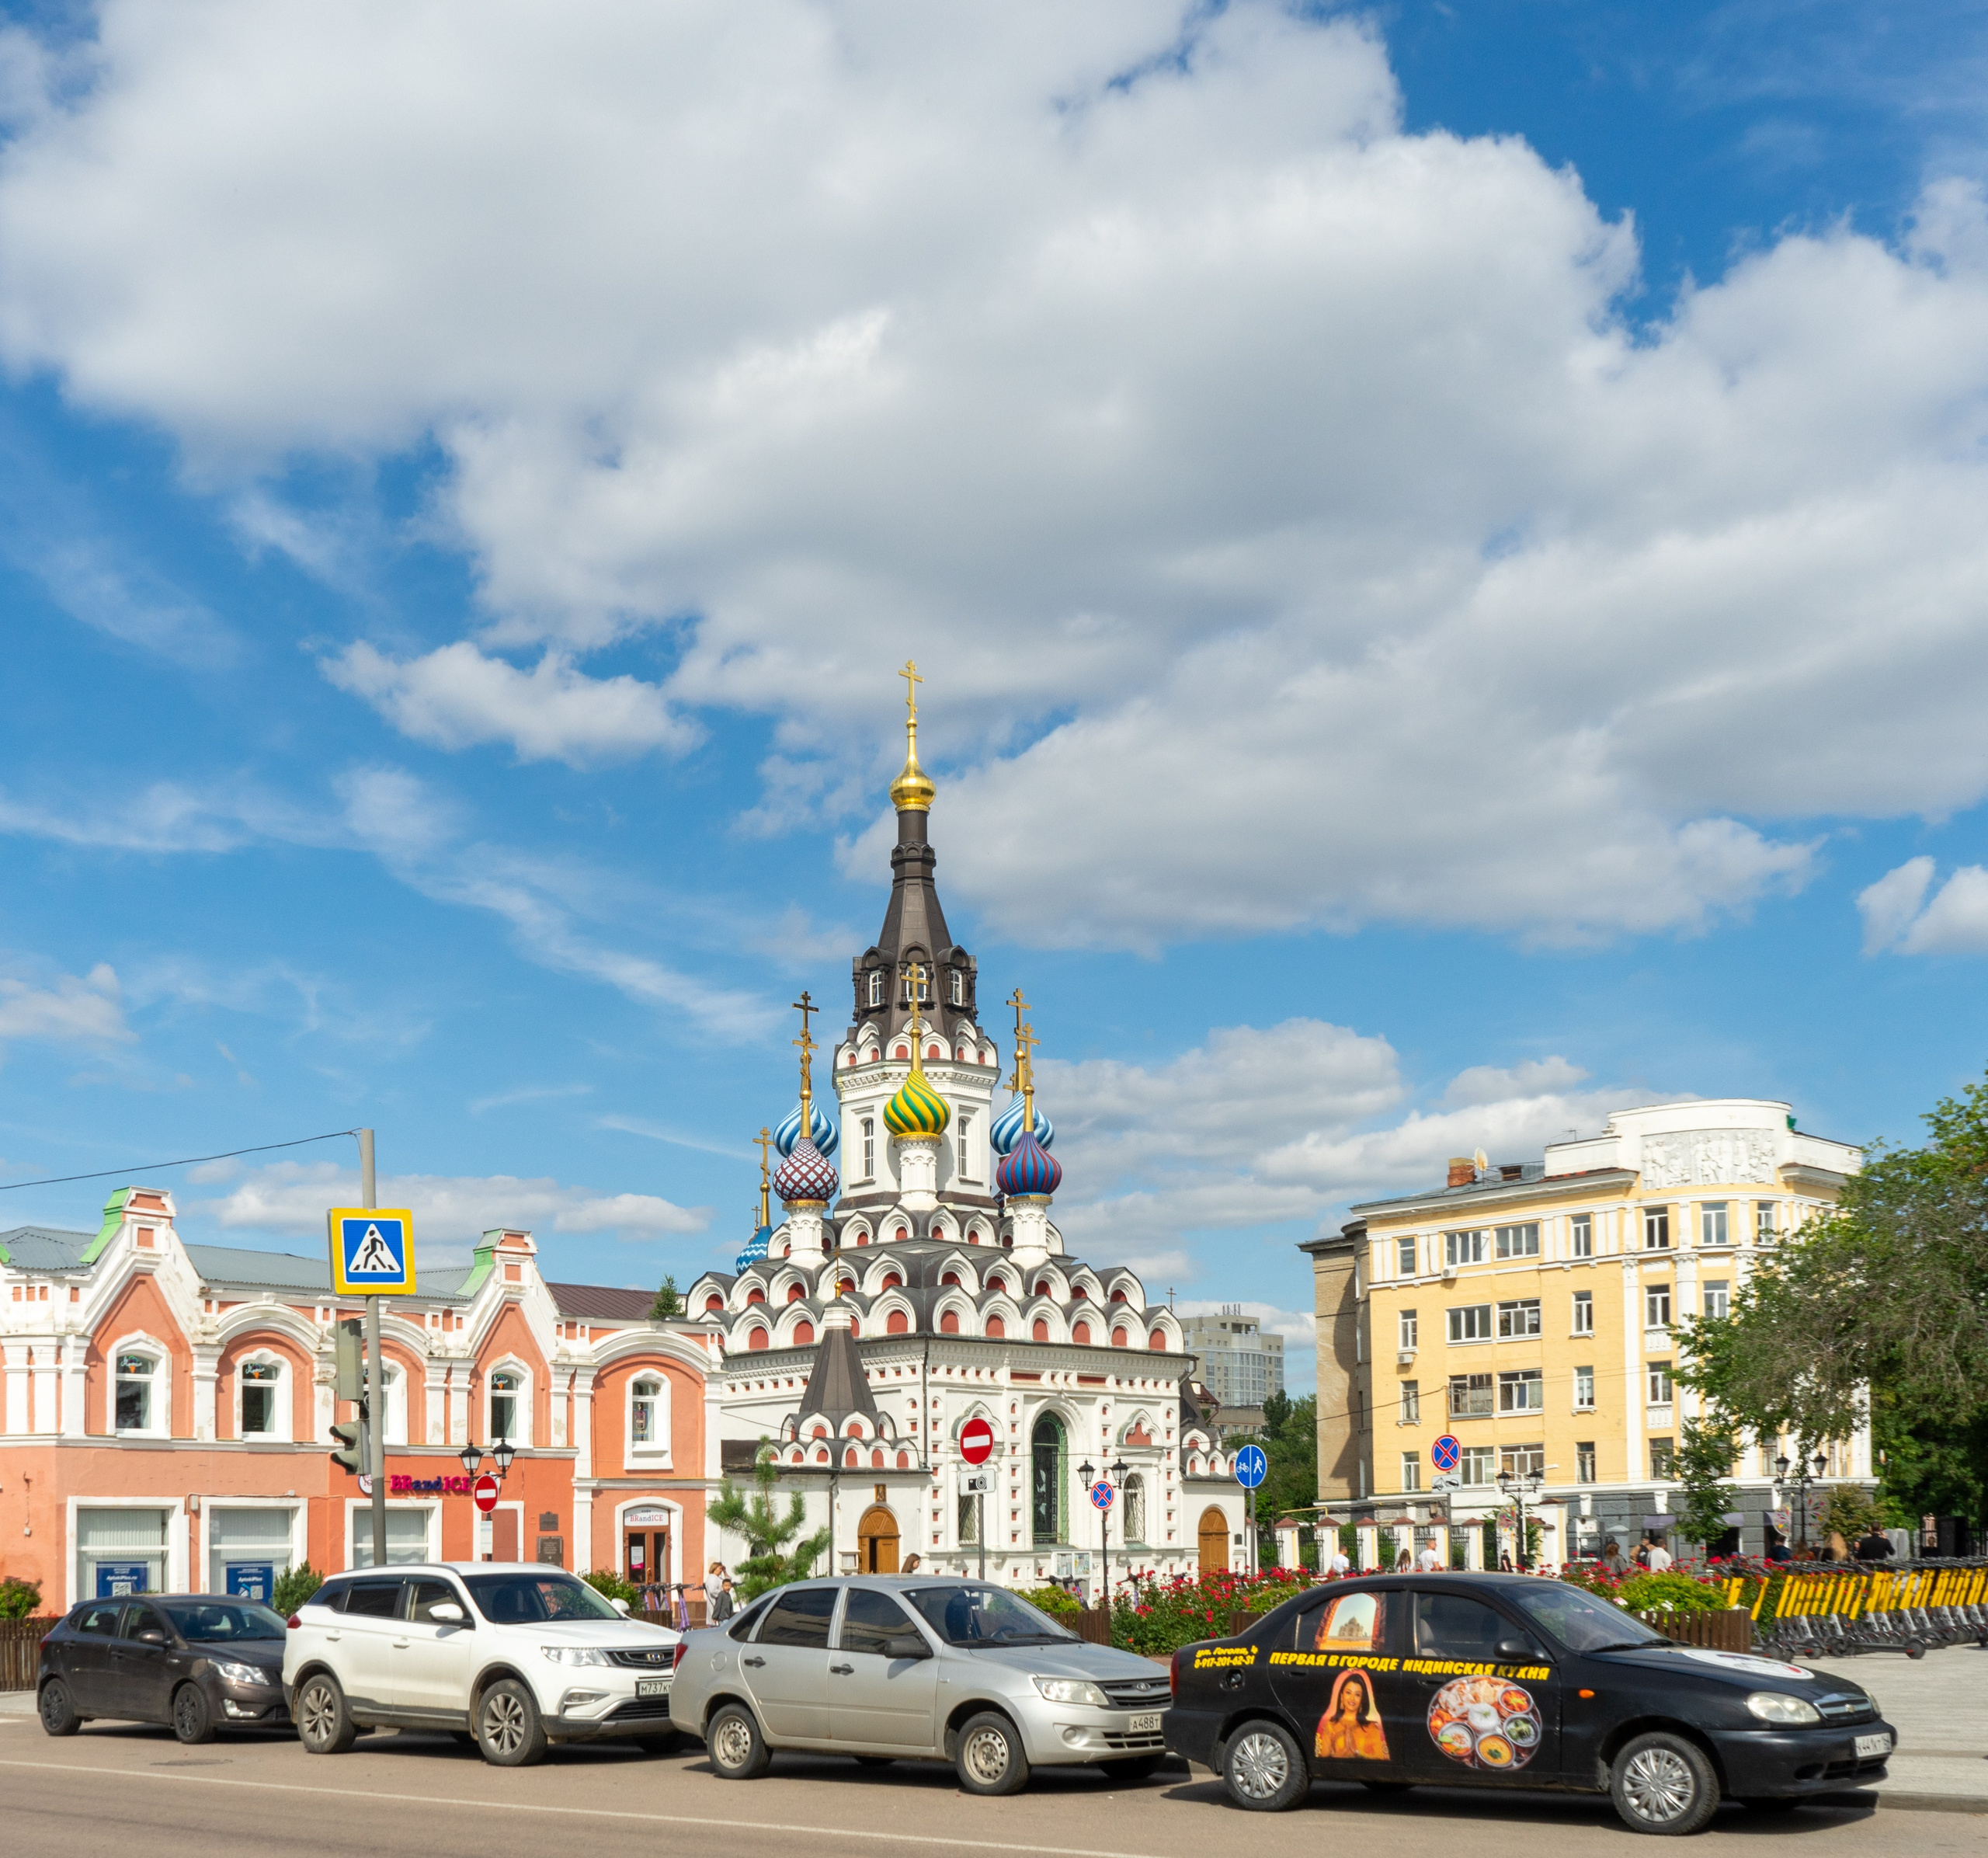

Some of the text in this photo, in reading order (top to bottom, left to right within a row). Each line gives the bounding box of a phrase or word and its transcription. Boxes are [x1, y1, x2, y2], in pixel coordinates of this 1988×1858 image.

[391, 1475, 471, 1491] BRandICE
[1194, 1654, 1255, 1668] 8-917-201-62-31
[1269, 1652, 1550, 1680] ПЕРВАЯ В ГОРОДЕ ИНДИЙСКАЯ КУХНЯ
